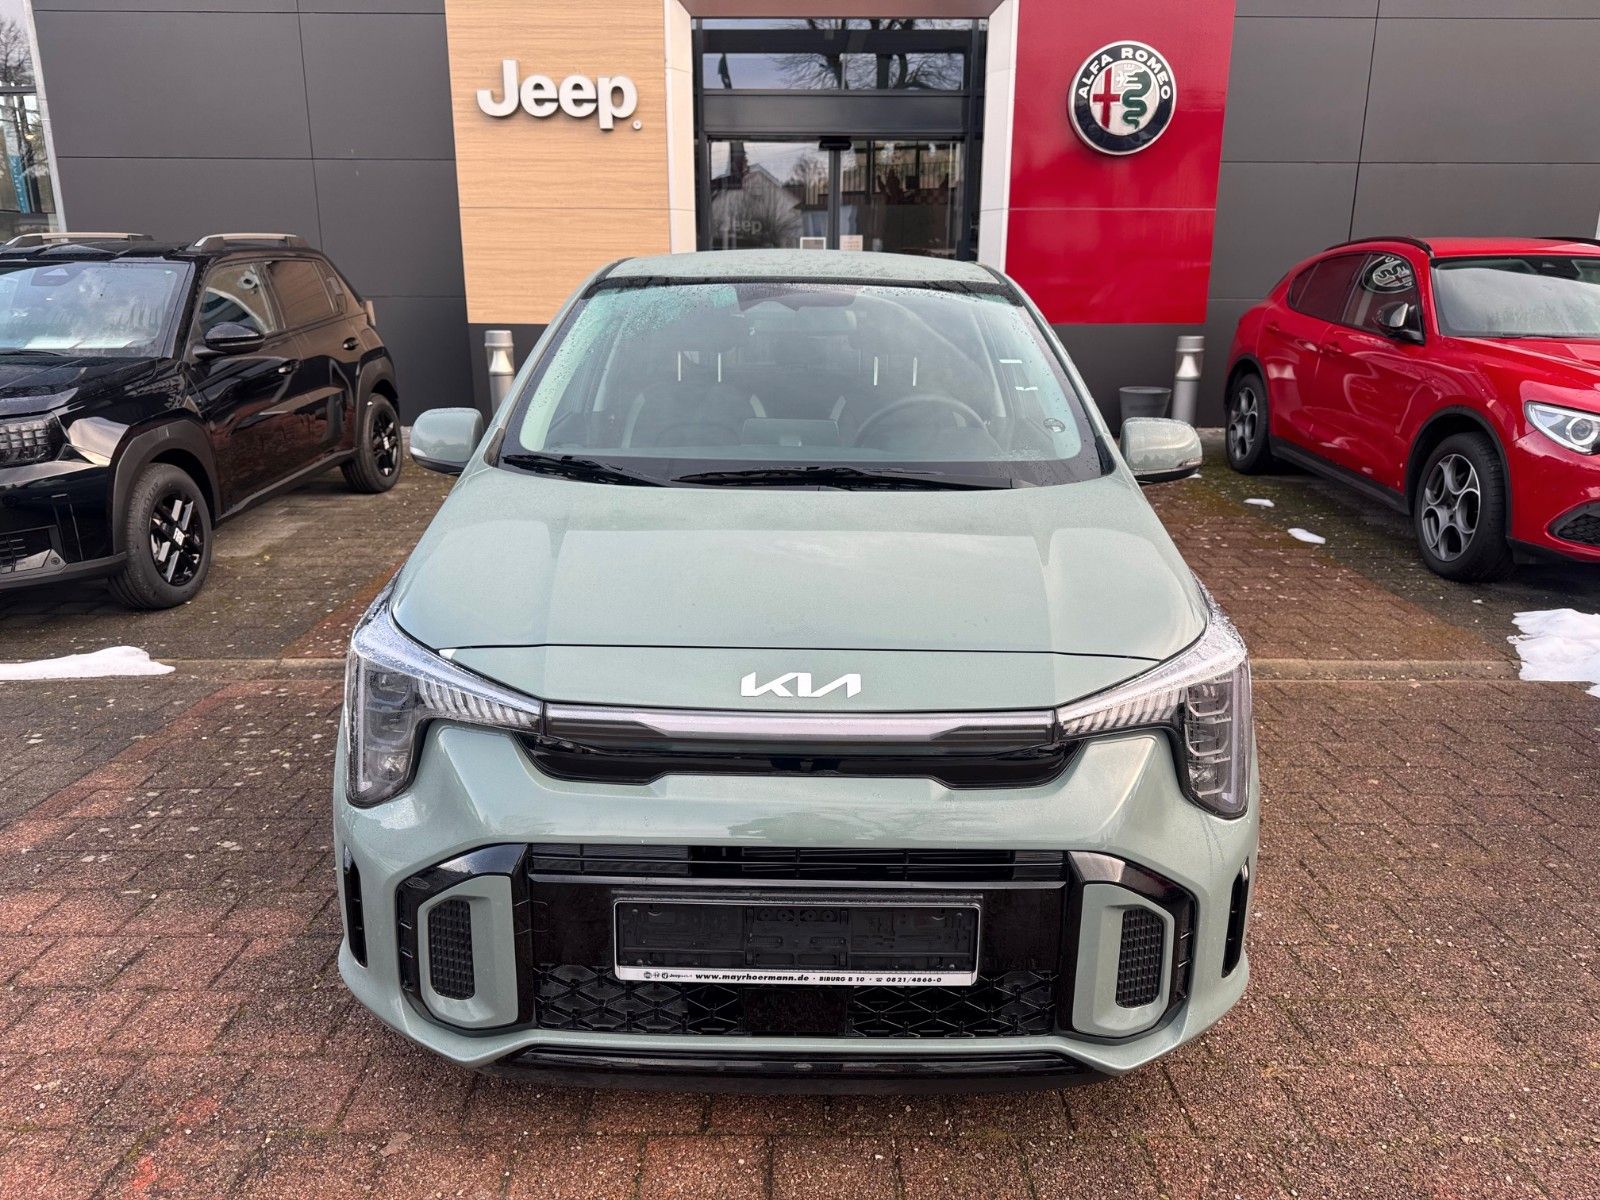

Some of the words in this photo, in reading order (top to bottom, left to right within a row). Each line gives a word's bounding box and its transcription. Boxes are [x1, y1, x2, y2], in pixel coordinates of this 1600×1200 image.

[476, 59, 638, 131] Jeep
[1078, 53, 1113, 99] ALFA
[1121, 47, 1171, 100] ROMEO
[695, 973, 810, 982] www.mayrhoermann.de
